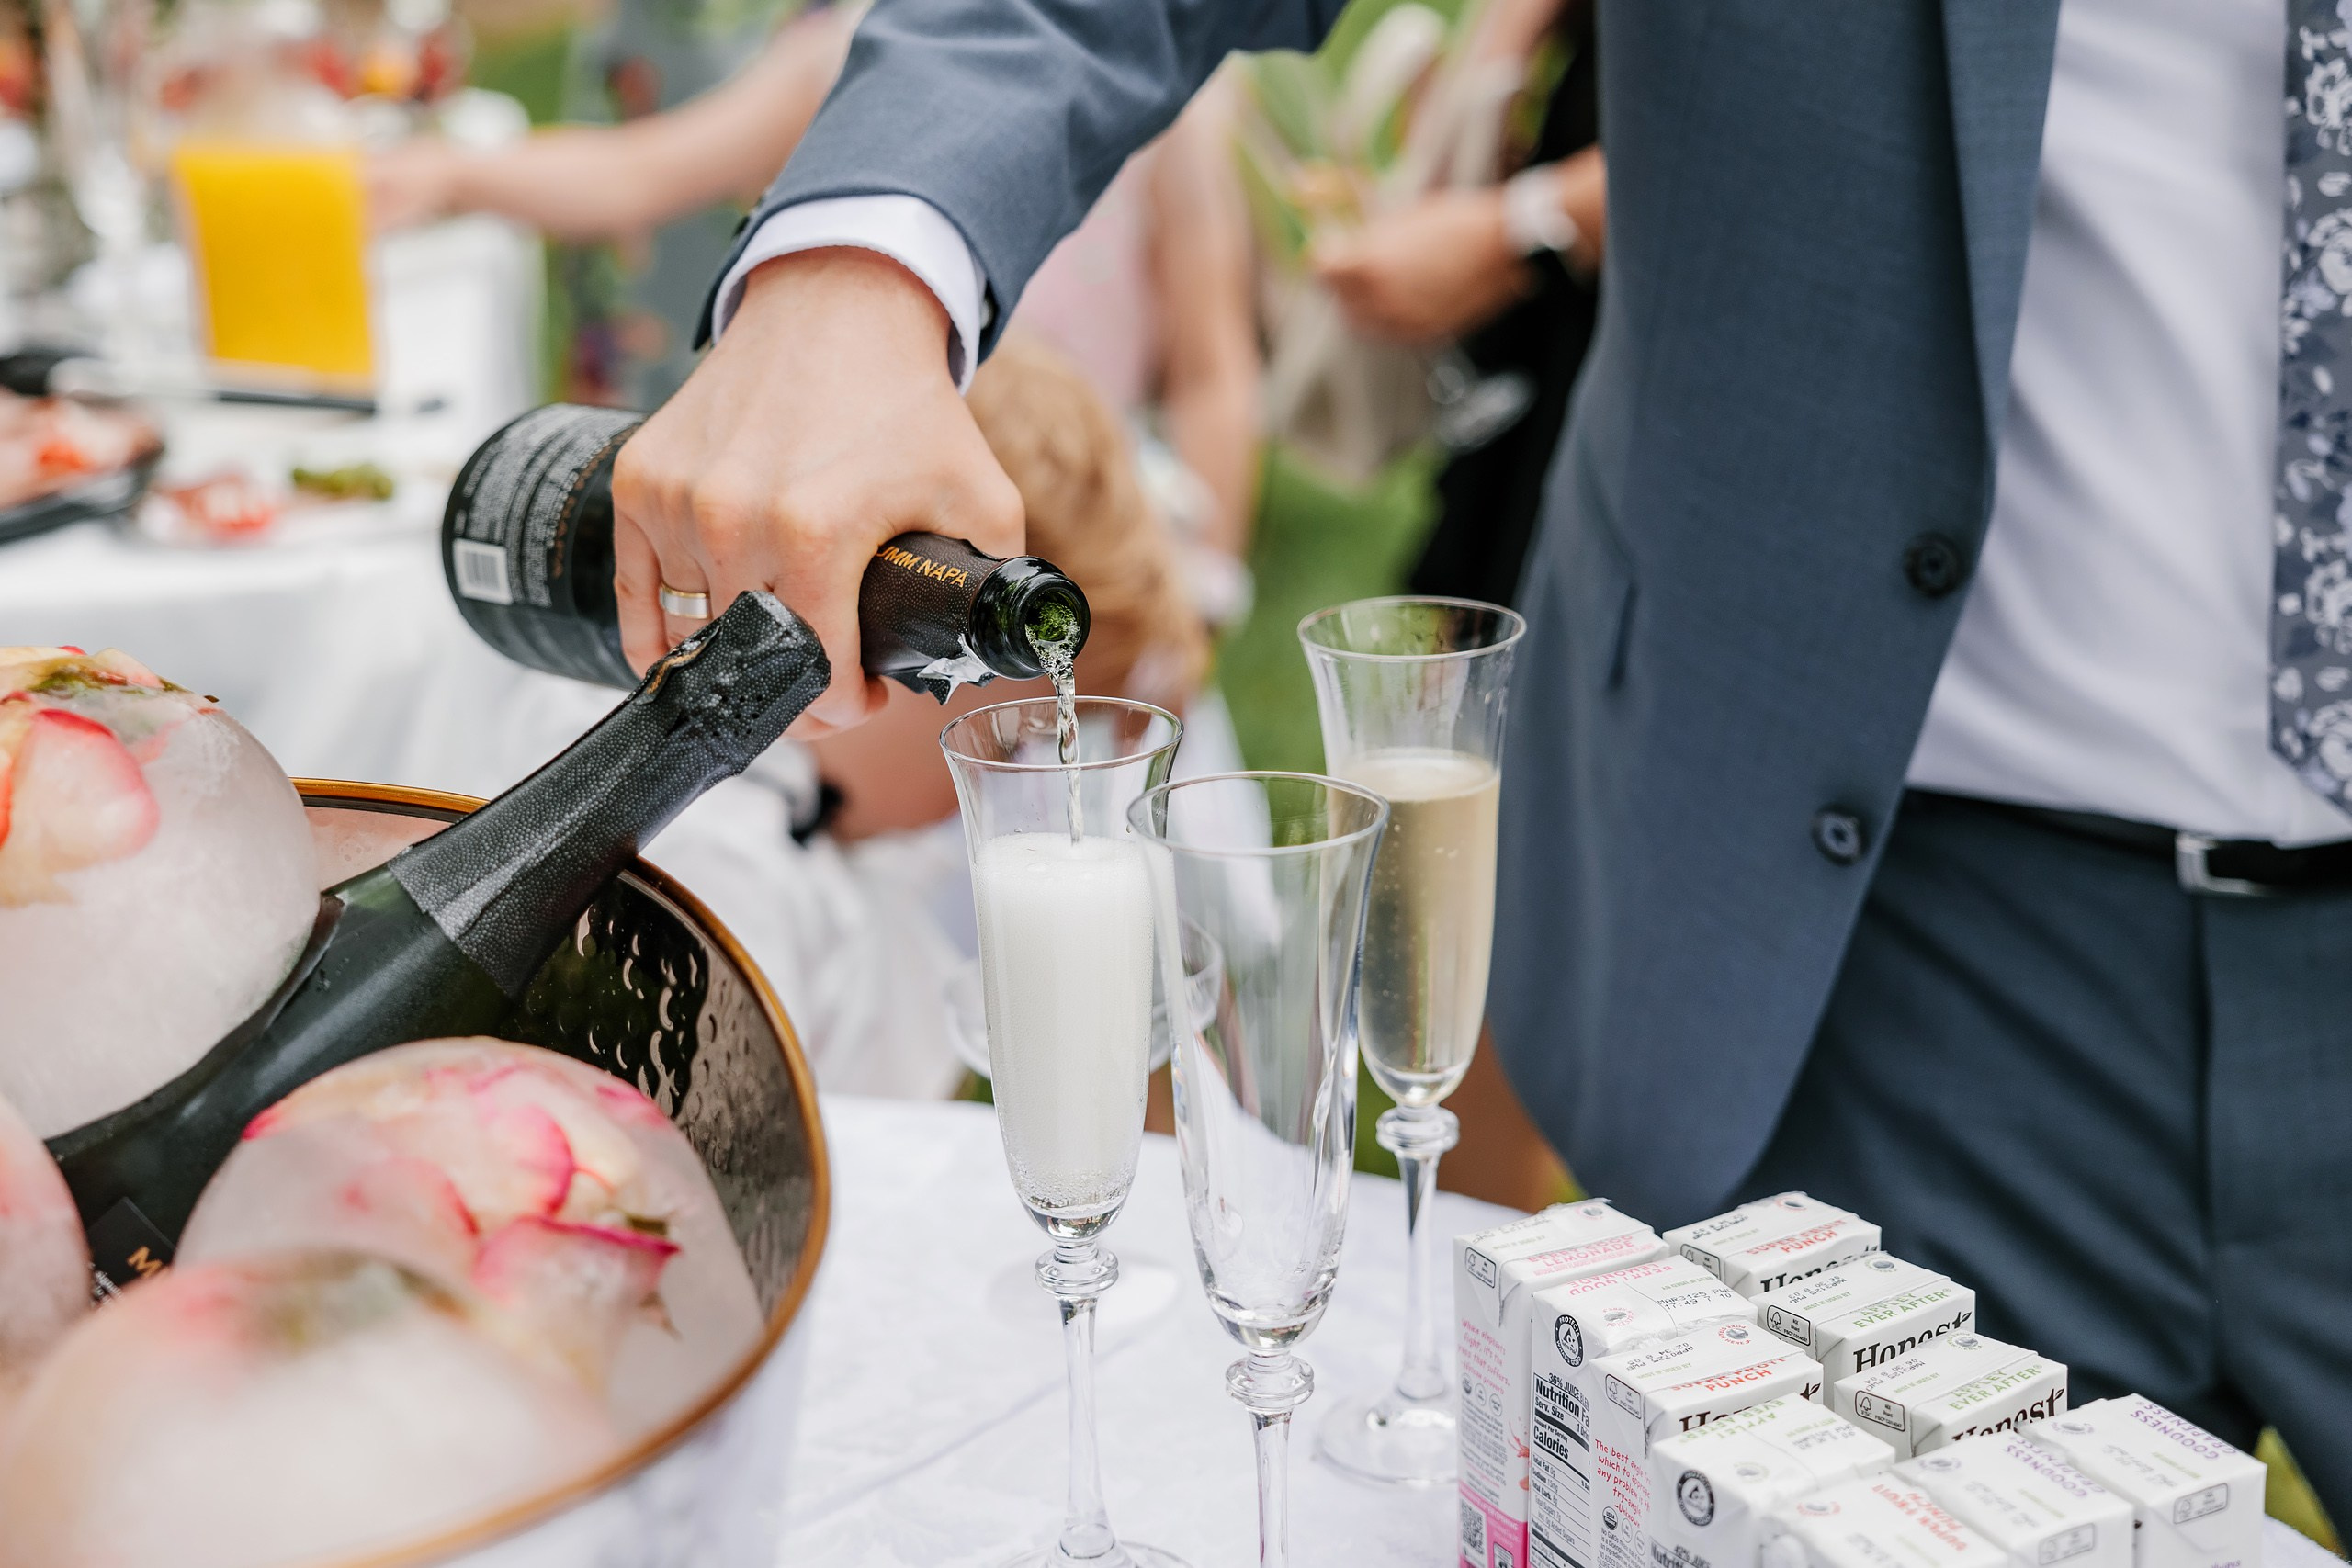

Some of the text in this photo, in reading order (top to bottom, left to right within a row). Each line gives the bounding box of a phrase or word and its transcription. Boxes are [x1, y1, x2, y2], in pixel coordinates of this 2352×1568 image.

[876, 546, 968, 588] UMM NAPA
[1543, 1240, 1634, 1267] LEMONADE
[1781, 1229, 1838, 1253] PUNCH
[1853, 1309, 1897, 1328] EVER
[1549, 1372, 1563, 1388] 36%
[1564, 1382, 1579, 1399] JUICE
[1705, 1369, 1772, 1391] PUNCH
[1535, 1396, 1550, 1413] Serv.
[1552, 1405, 1564, 1421] Size
[1536, 1379, 1579, 1417] Nutrition
[1950, 1389, 1992, 1410] EVER
[1534, 1425, 1569, 1460] Calories
[2131, 1409, 2220, 1460] GOODNESS
[1595, 1438, 1609, 1453] The
[1611, 1447, 1629, 1464] best
[1599, 1456, 1621, 1472] which
[1623, 1466, 1631, 1477] to
[1597, 1468, 1611, 1482] any
[1613, 1476, 1638, 1498] problem
